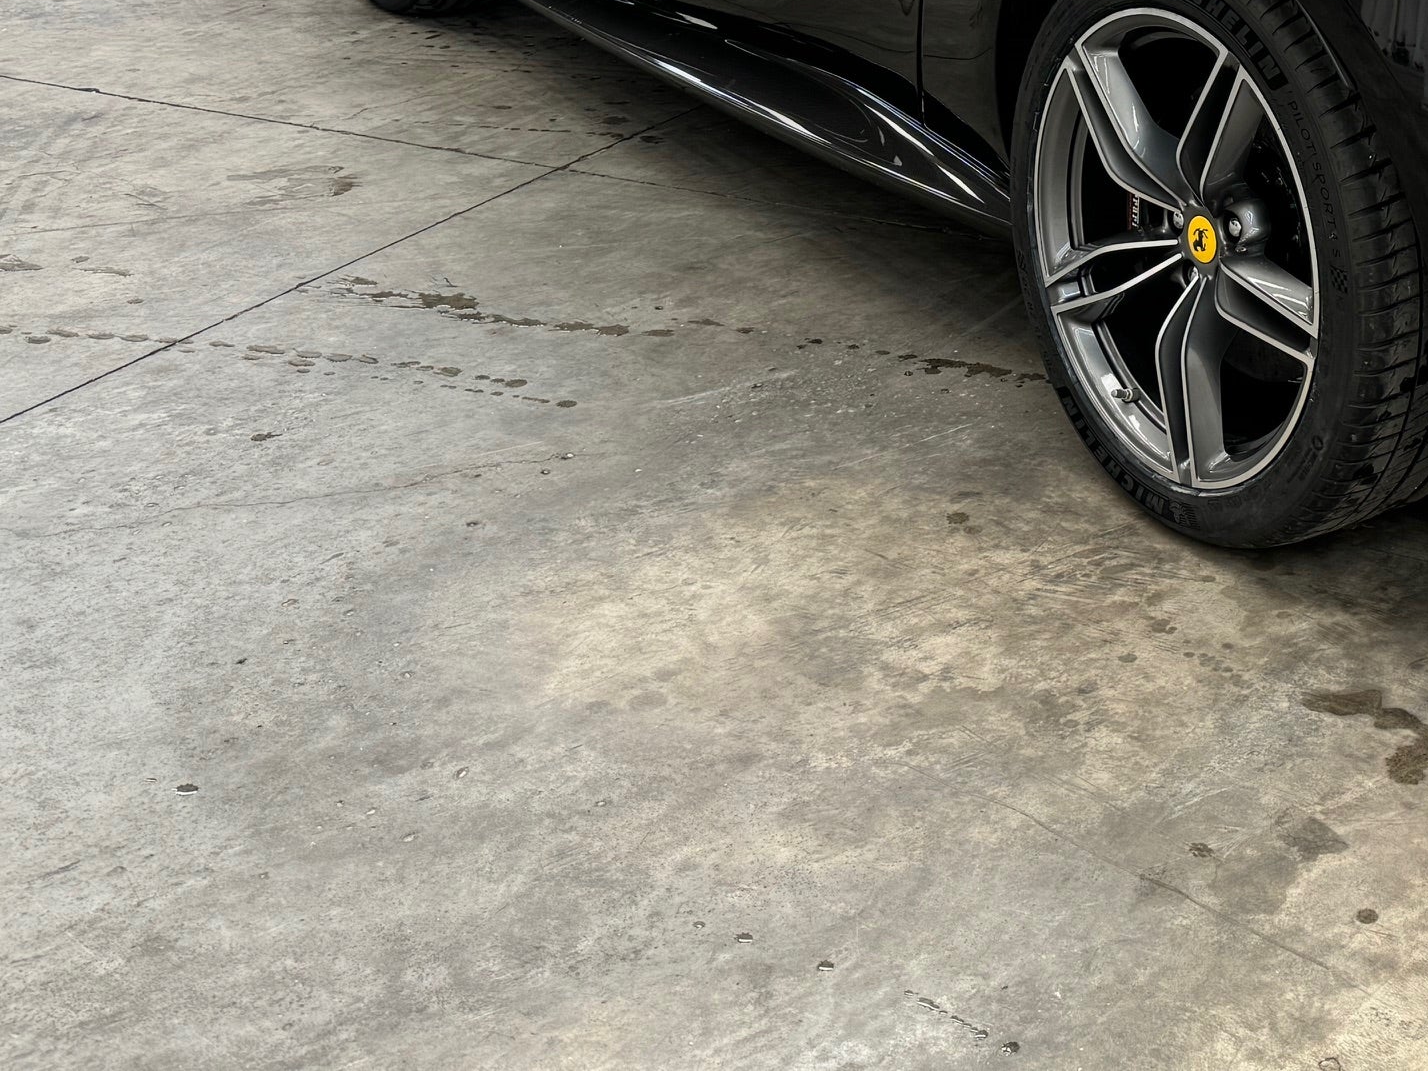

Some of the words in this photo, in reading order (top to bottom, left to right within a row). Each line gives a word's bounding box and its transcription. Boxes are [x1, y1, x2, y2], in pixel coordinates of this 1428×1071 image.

[1287, 100, 1317, 156] PILOT
[1311, 161, 1337, 229] SPORT
[1062, 396, 1165, 515] MICHELIN
